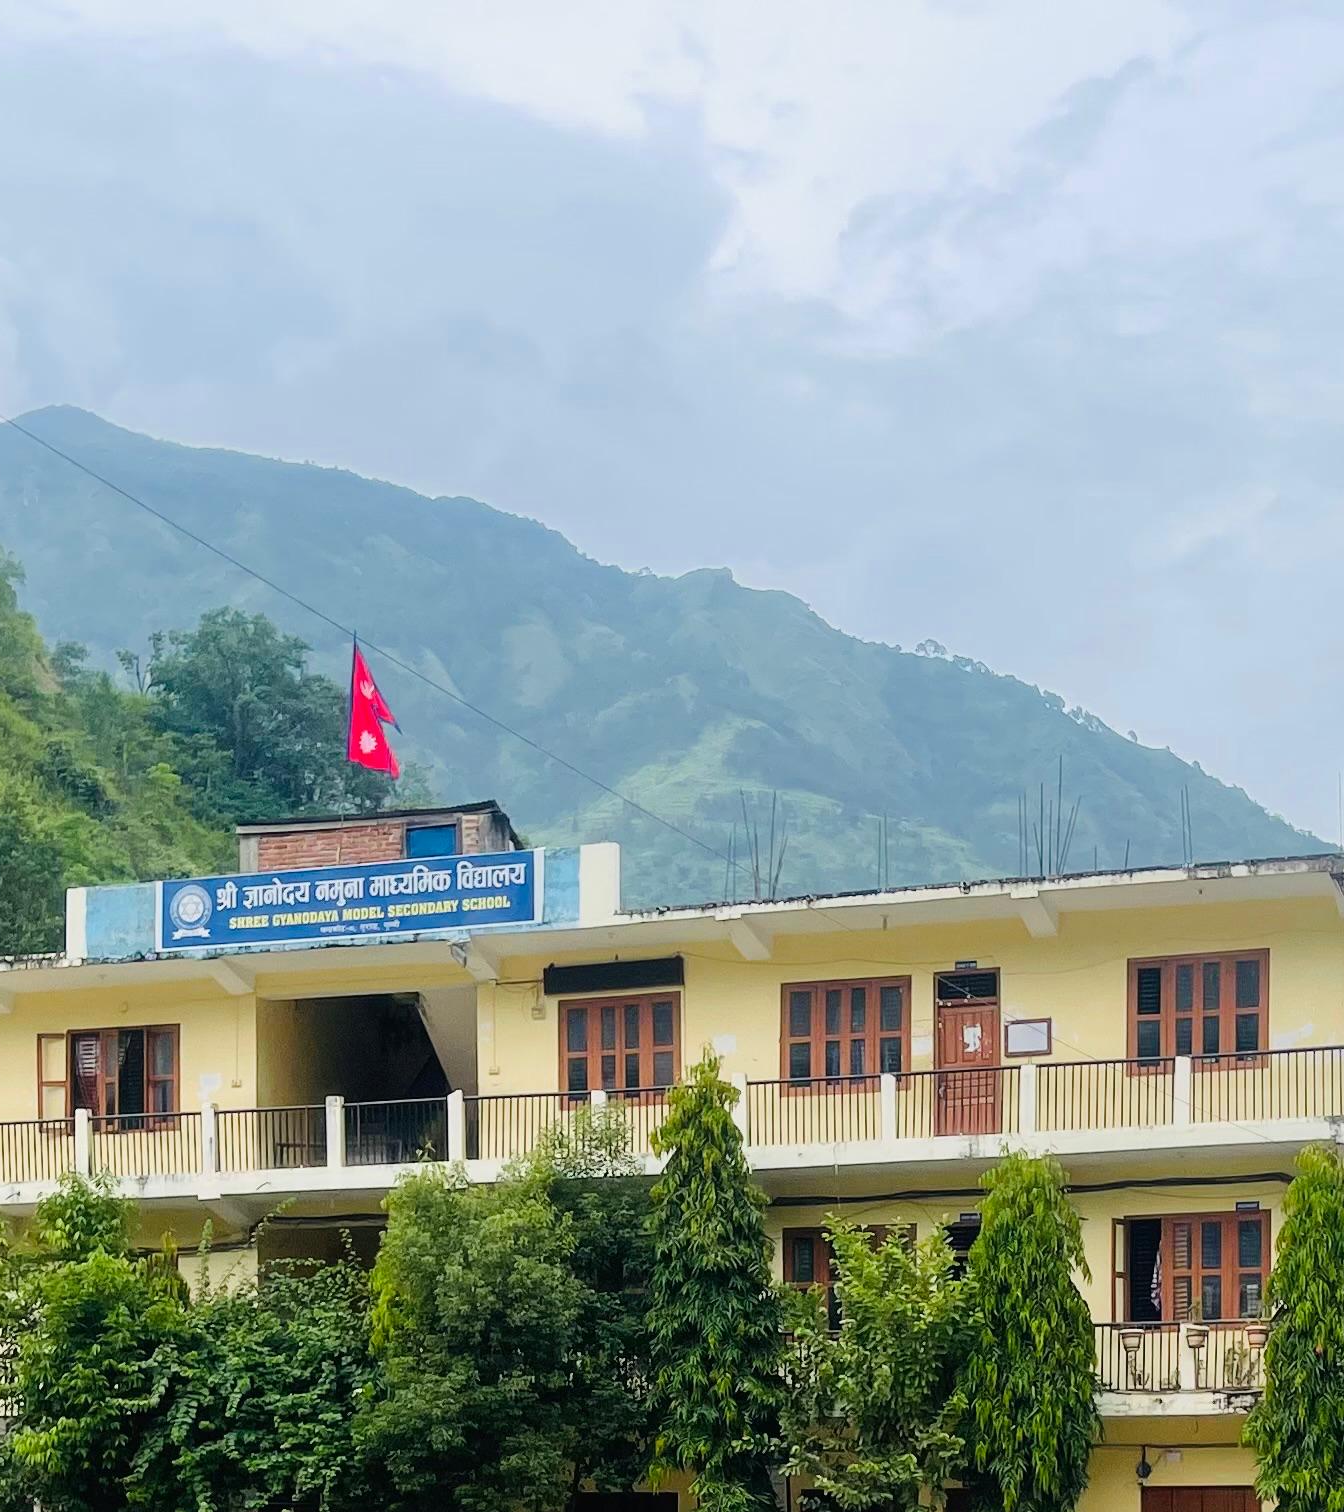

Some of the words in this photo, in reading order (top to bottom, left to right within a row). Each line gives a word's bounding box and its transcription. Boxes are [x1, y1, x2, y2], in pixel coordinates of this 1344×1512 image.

[216, 881, 238, 911] श्री
[242, 878, 311, 909] ज्ञानोदय
[369, 865, 452, 897] माध्यमिक
[456, 861, 527, 890] विद्यालय
[229, 915, 269, 929] SHREE
[272, 909, 339, 927] GYANODAYA
[342, 906, 384, 921] MODEL
[388, 900, 459, 918] SECONDARY
[462, 896, 510, 911] SCHOOL
